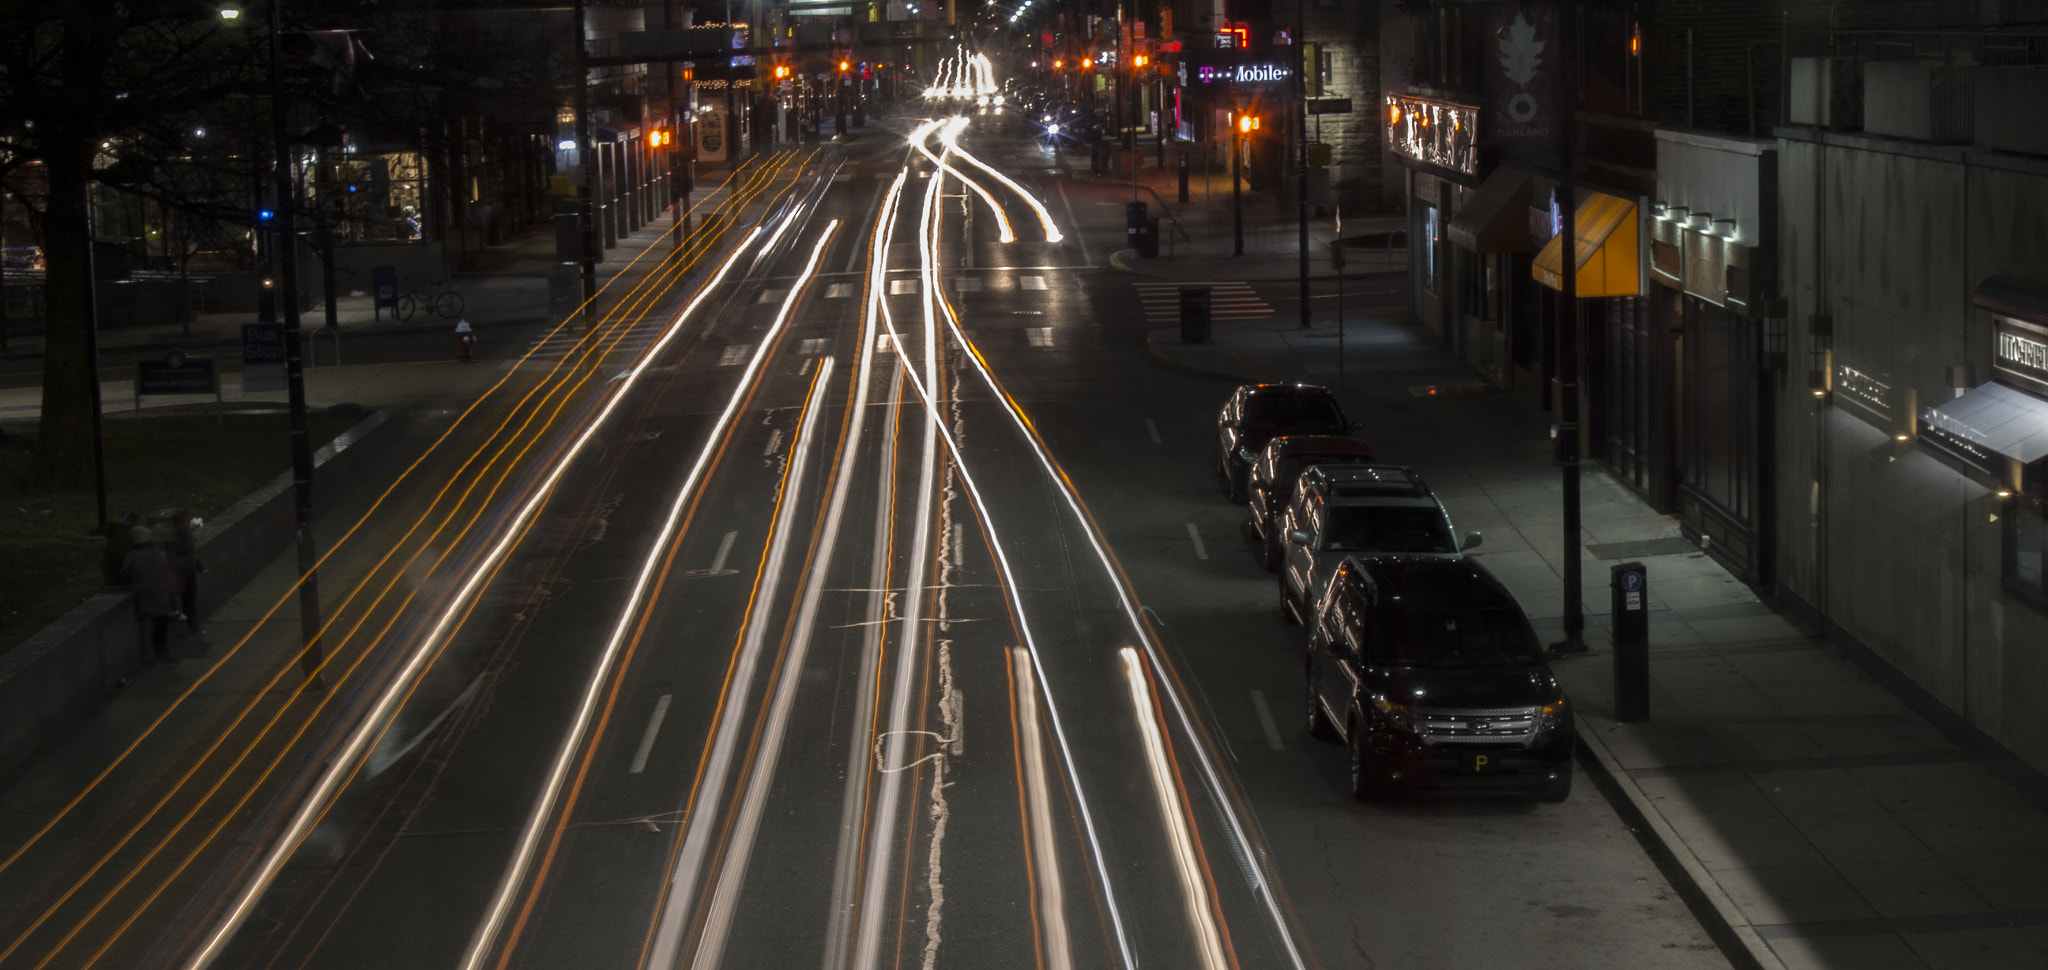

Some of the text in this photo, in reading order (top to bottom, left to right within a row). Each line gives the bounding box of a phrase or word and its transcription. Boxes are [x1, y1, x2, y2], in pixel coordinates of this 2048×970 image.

[1496, 127, 1549, 138] OAKLAND
[248, 329, 278, 341] Bus
[245, 345, 282, 360] Stop
[1627, 574, 1638, 589] P
[1476, 755, 1488, 771] P
